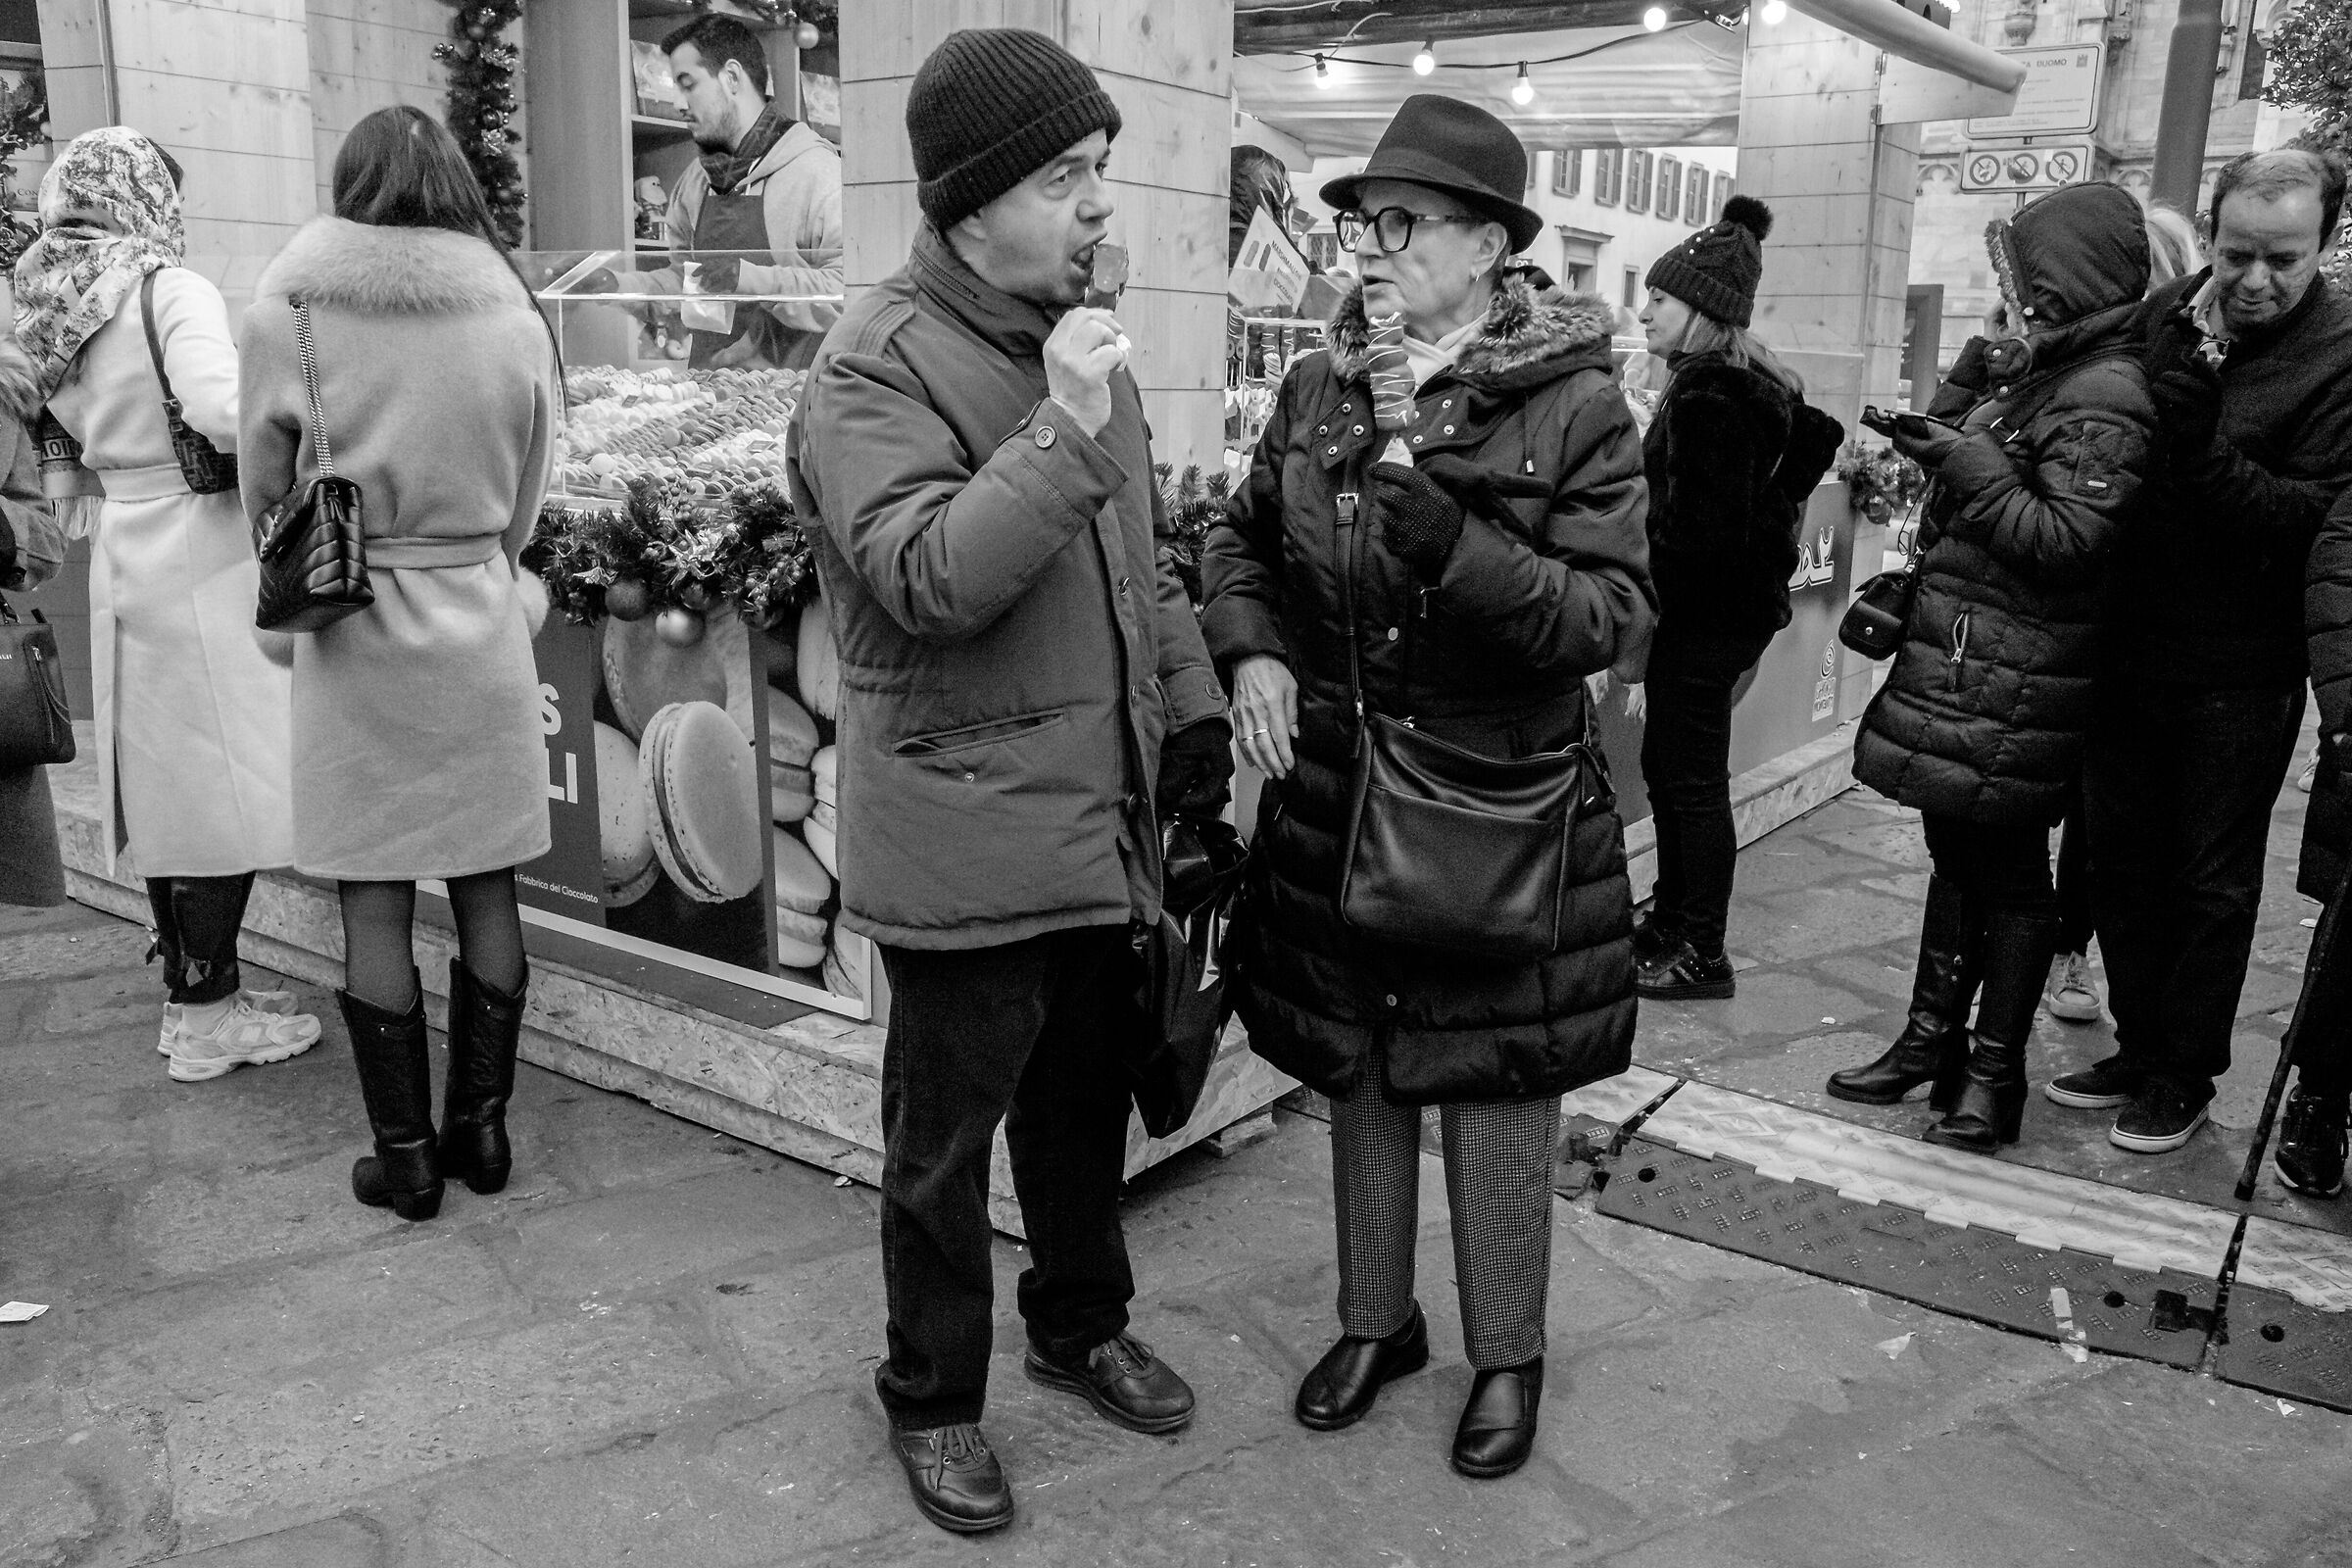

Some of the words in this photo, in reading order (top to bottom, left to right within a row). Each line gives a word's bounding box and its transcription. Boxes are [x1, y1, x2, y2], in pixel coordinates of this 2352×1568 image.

[518, 874, 548, 890] Fabbrica
[550, 883, 561, 893] del
[562, 886, 599, 904] Cioccolato
